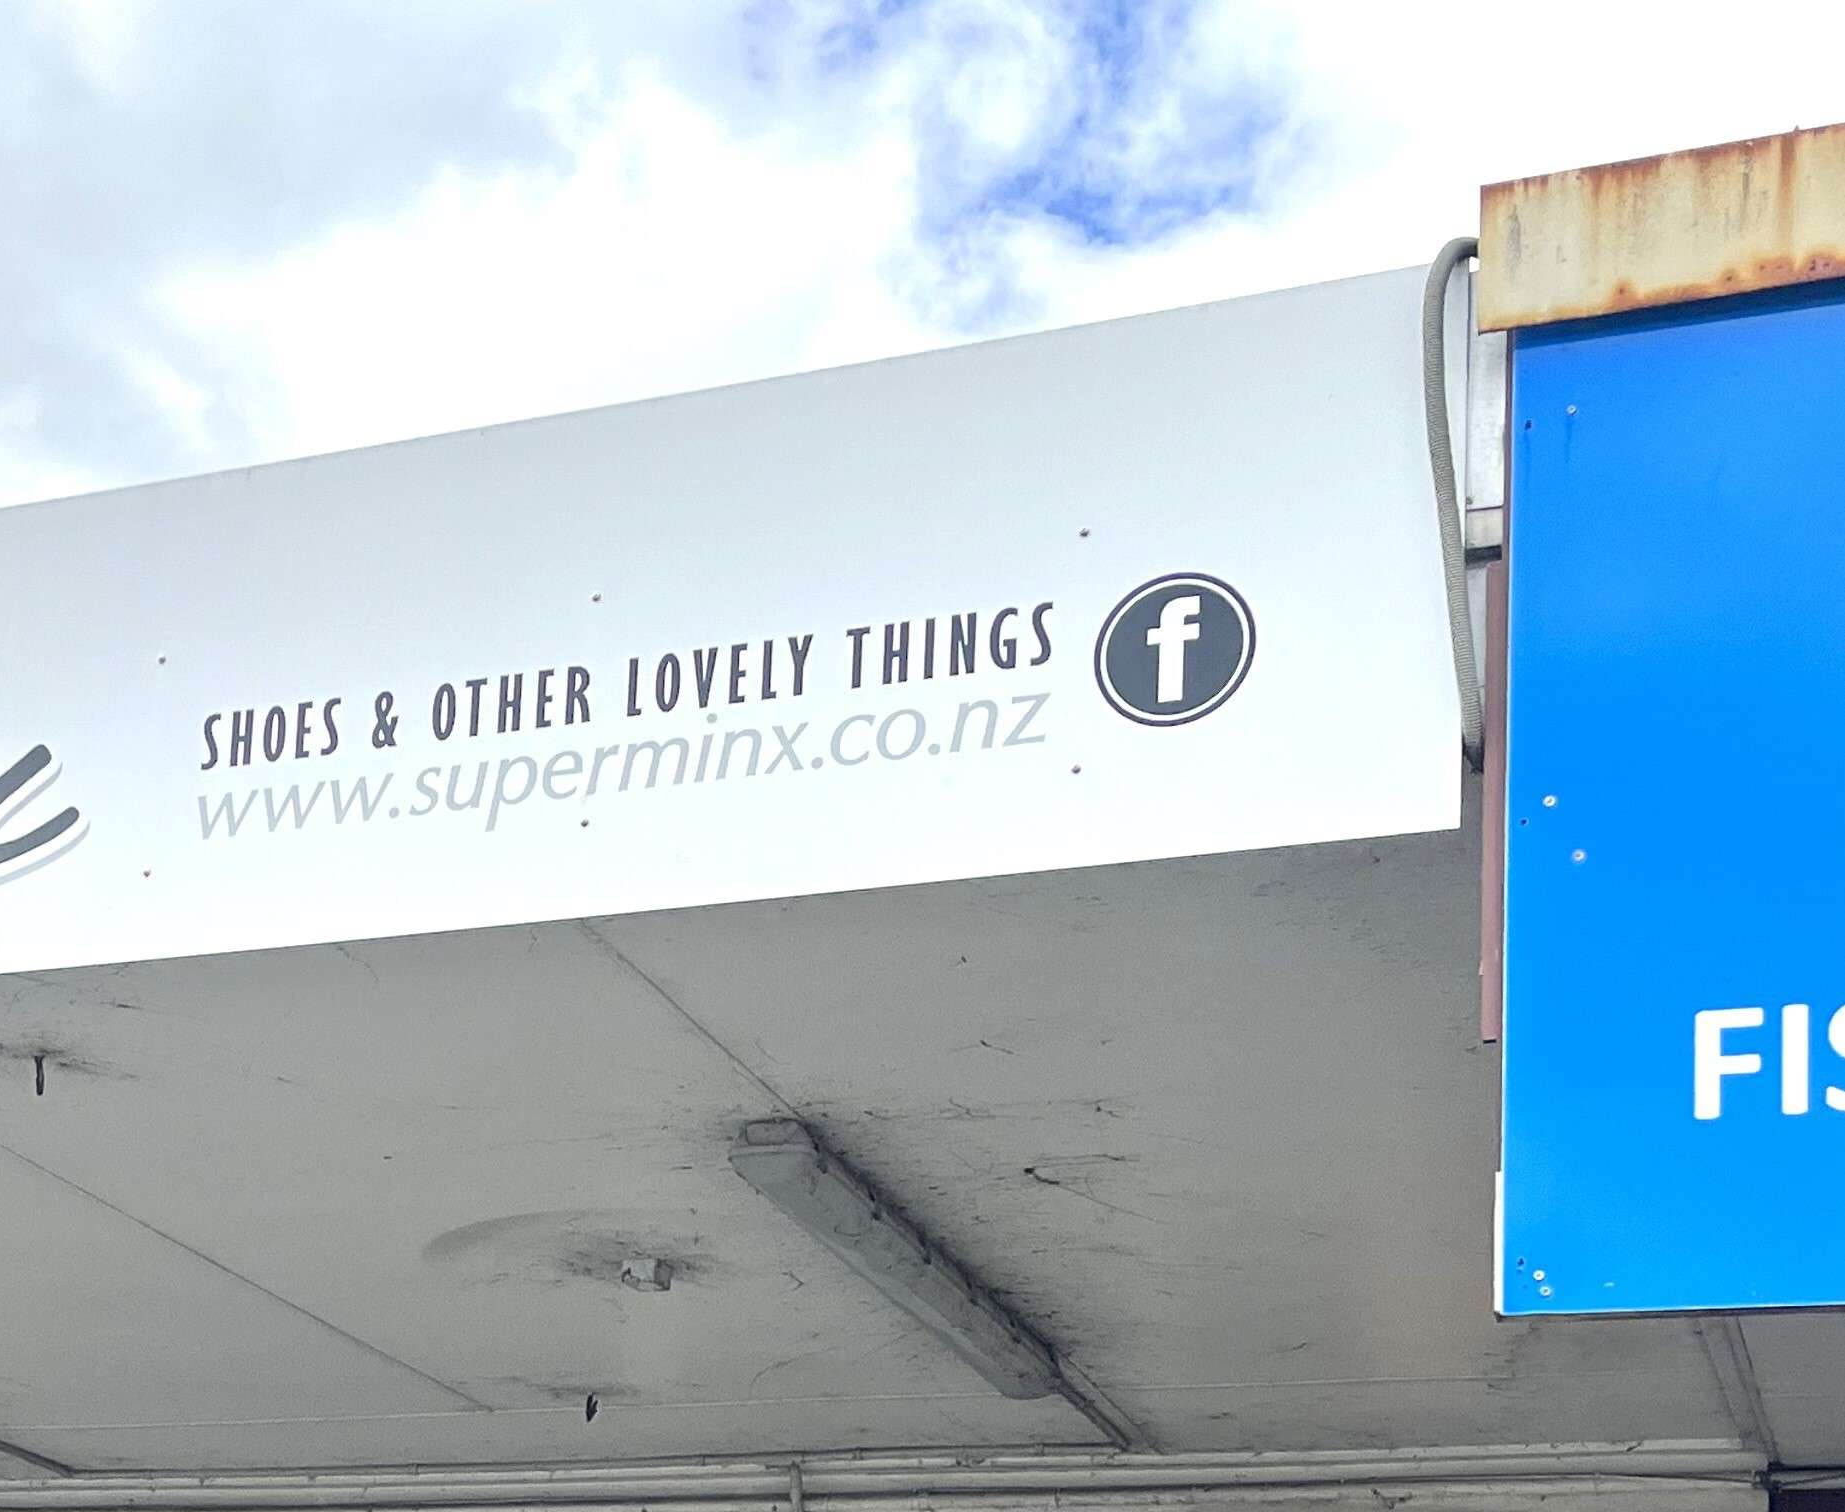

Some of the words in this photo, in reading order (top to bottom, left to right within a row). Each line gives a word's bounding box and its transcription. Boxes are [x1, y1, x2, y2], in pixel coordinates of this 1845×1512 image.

[195, 686, 1049, 842] www.superminx.co.nz
[200, 697, 340, 771] SHOES
[370, 694, 401, 750] &
[431, 666, 592, 744] OTHER
[626, 631, 816, 715] LOVELY
[846, 600, 1056, 688] THINGS
